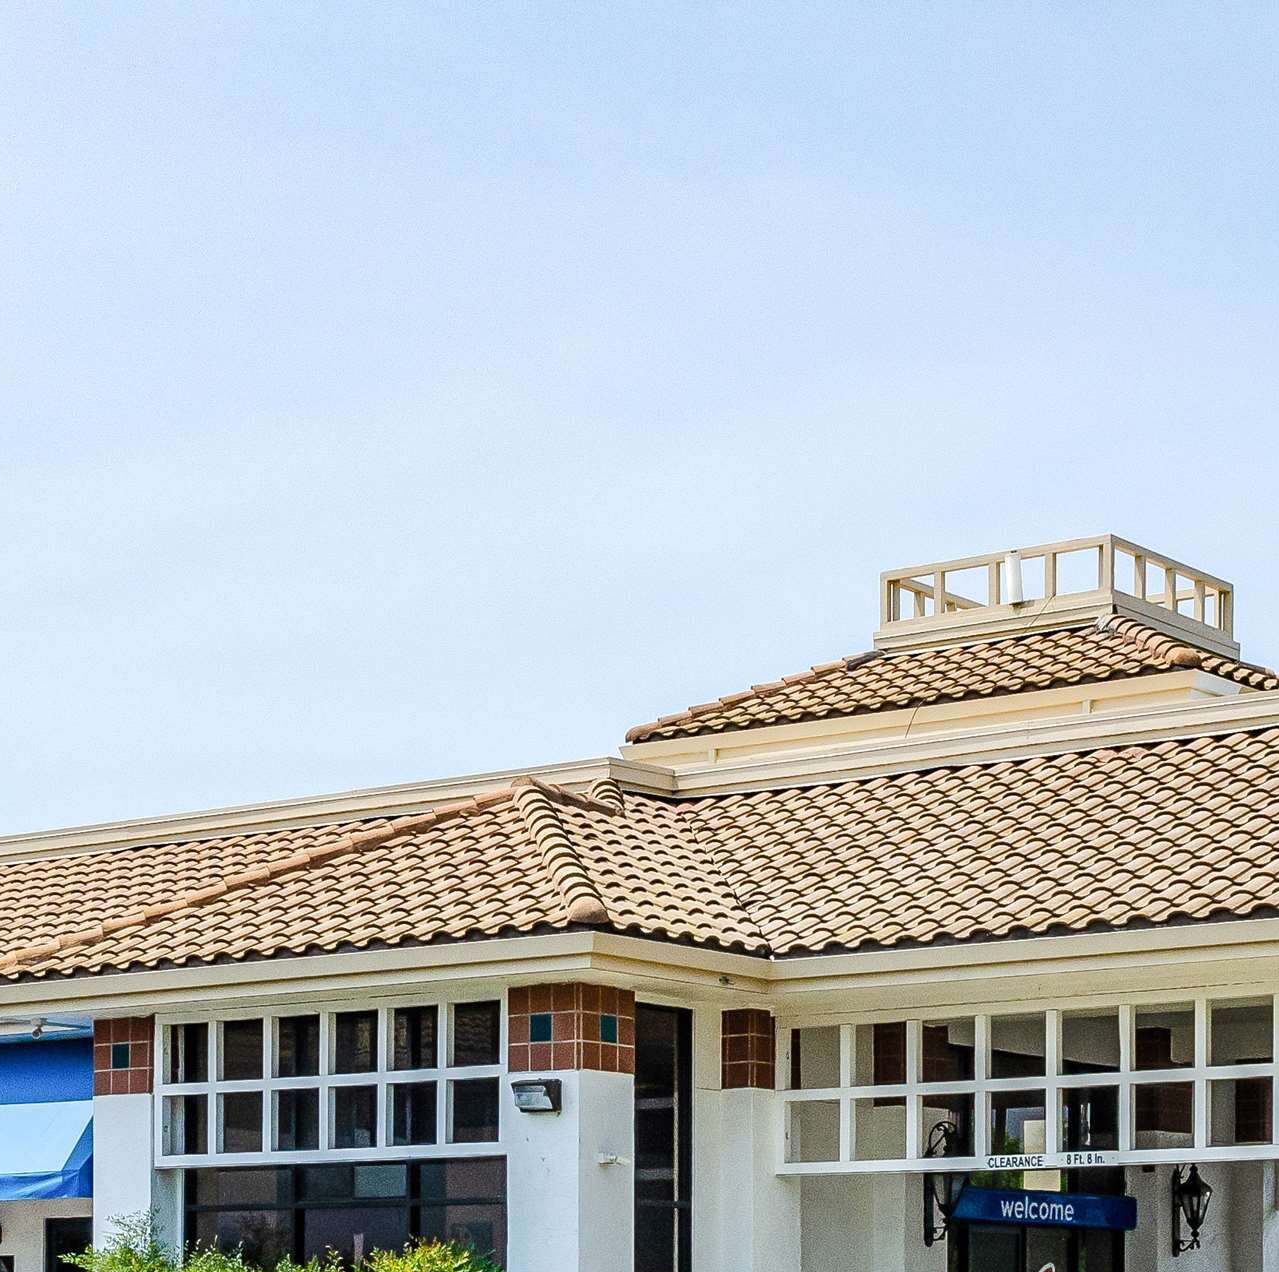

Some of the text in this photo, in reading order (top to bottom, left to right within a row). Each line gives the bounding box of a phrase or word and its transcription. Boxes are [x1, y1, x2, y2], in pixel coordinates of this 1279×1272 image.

[988, 1152, 1106, 1169] CLEARANCE 8 Ft. 8 In.
[1000, 1195, 1075, 1221] welcome
